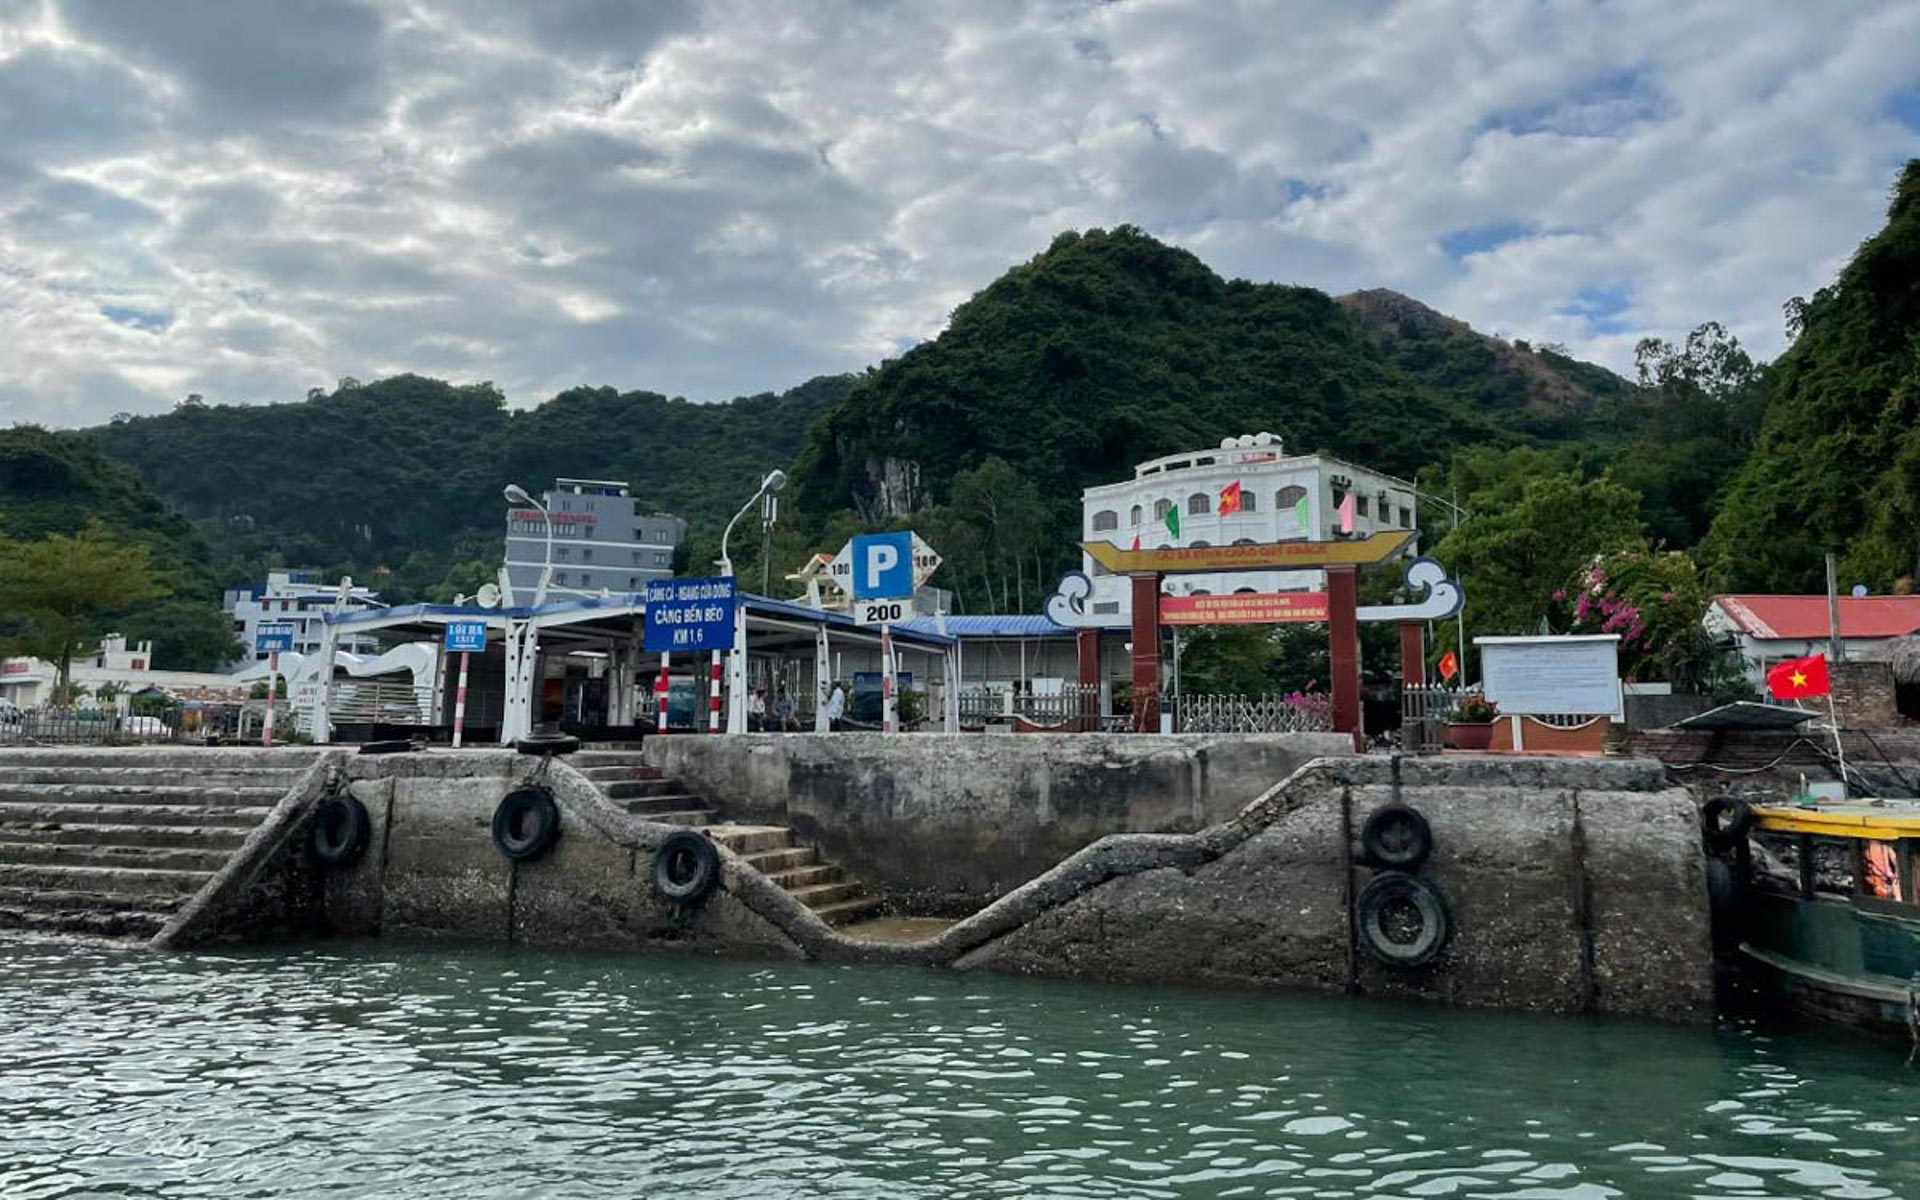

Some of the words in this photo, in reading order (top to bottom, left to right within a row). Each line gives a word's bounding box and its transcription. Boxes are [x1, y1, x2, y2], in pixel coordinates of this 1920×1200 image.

[832, 563, 850, 576] 100
[867, 544, 898, 588] P
[655, 604, 682, 625] CẢNG
[683, 603, 703, 623] BẾN
[704, 603, 724, 622] BÈO
[867, 604, 901, 622] 200
[673, 628, 688, 645] KM
